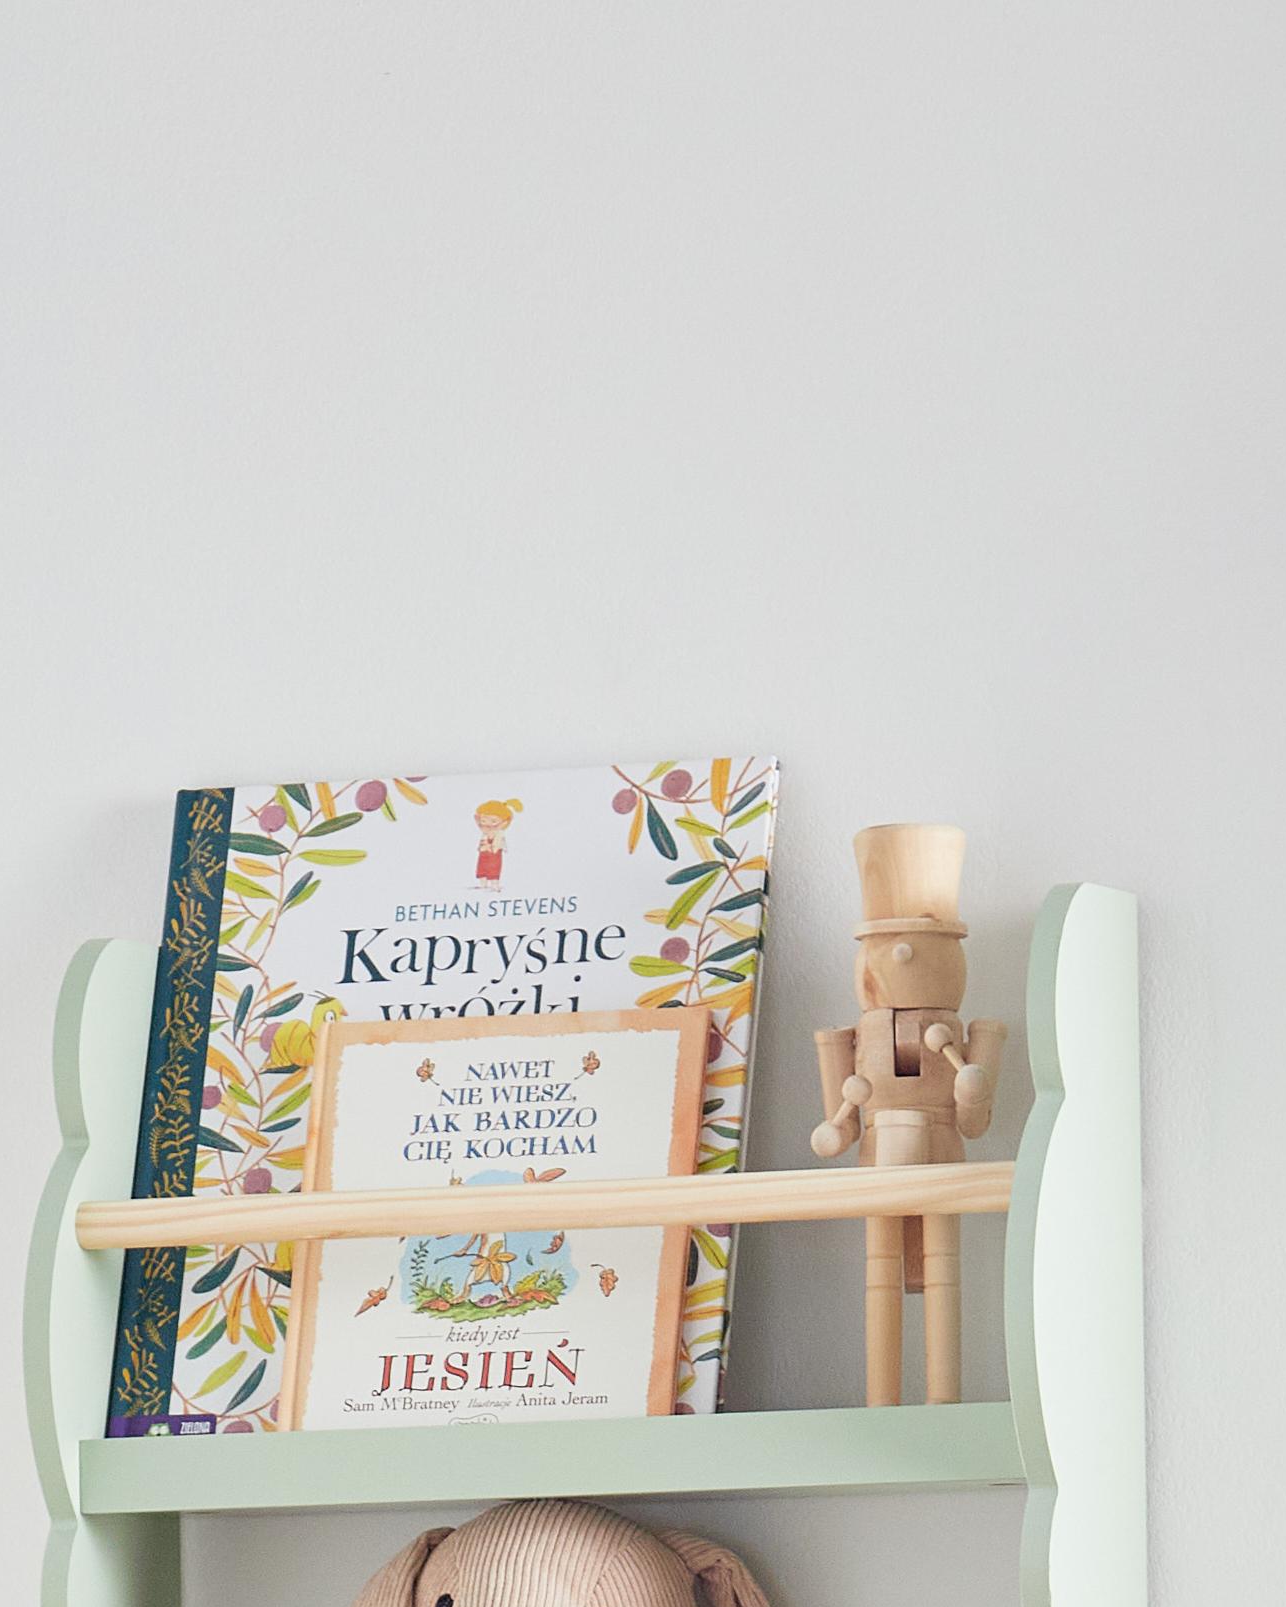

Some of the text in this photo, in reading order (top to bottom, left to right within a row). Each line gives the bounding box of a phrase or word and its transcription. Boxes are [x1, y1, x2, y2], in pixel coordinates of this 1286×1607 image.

[395, 896, 578, 922] BETHAN STEVENS
[335, 923, 626, 986] Kapryśne
[465, 1059, 555, 1081] NAWET
[438, 1083, 577, 1106] NIE WIESZ,
[410, 1107, 597, 1136] JAK BARDZO
[403, 1134, 597, 1164] CIĘ KOCHAM
[445, 1326, 520, 1347] kiedy jest
[371, 1338, 586, 1397] JESIEŃ
[343, 1398, 375, 1413] Sam
[516, 1392, 556, 1407] Anita
[561, 1391, 608, 1405] Jeram
